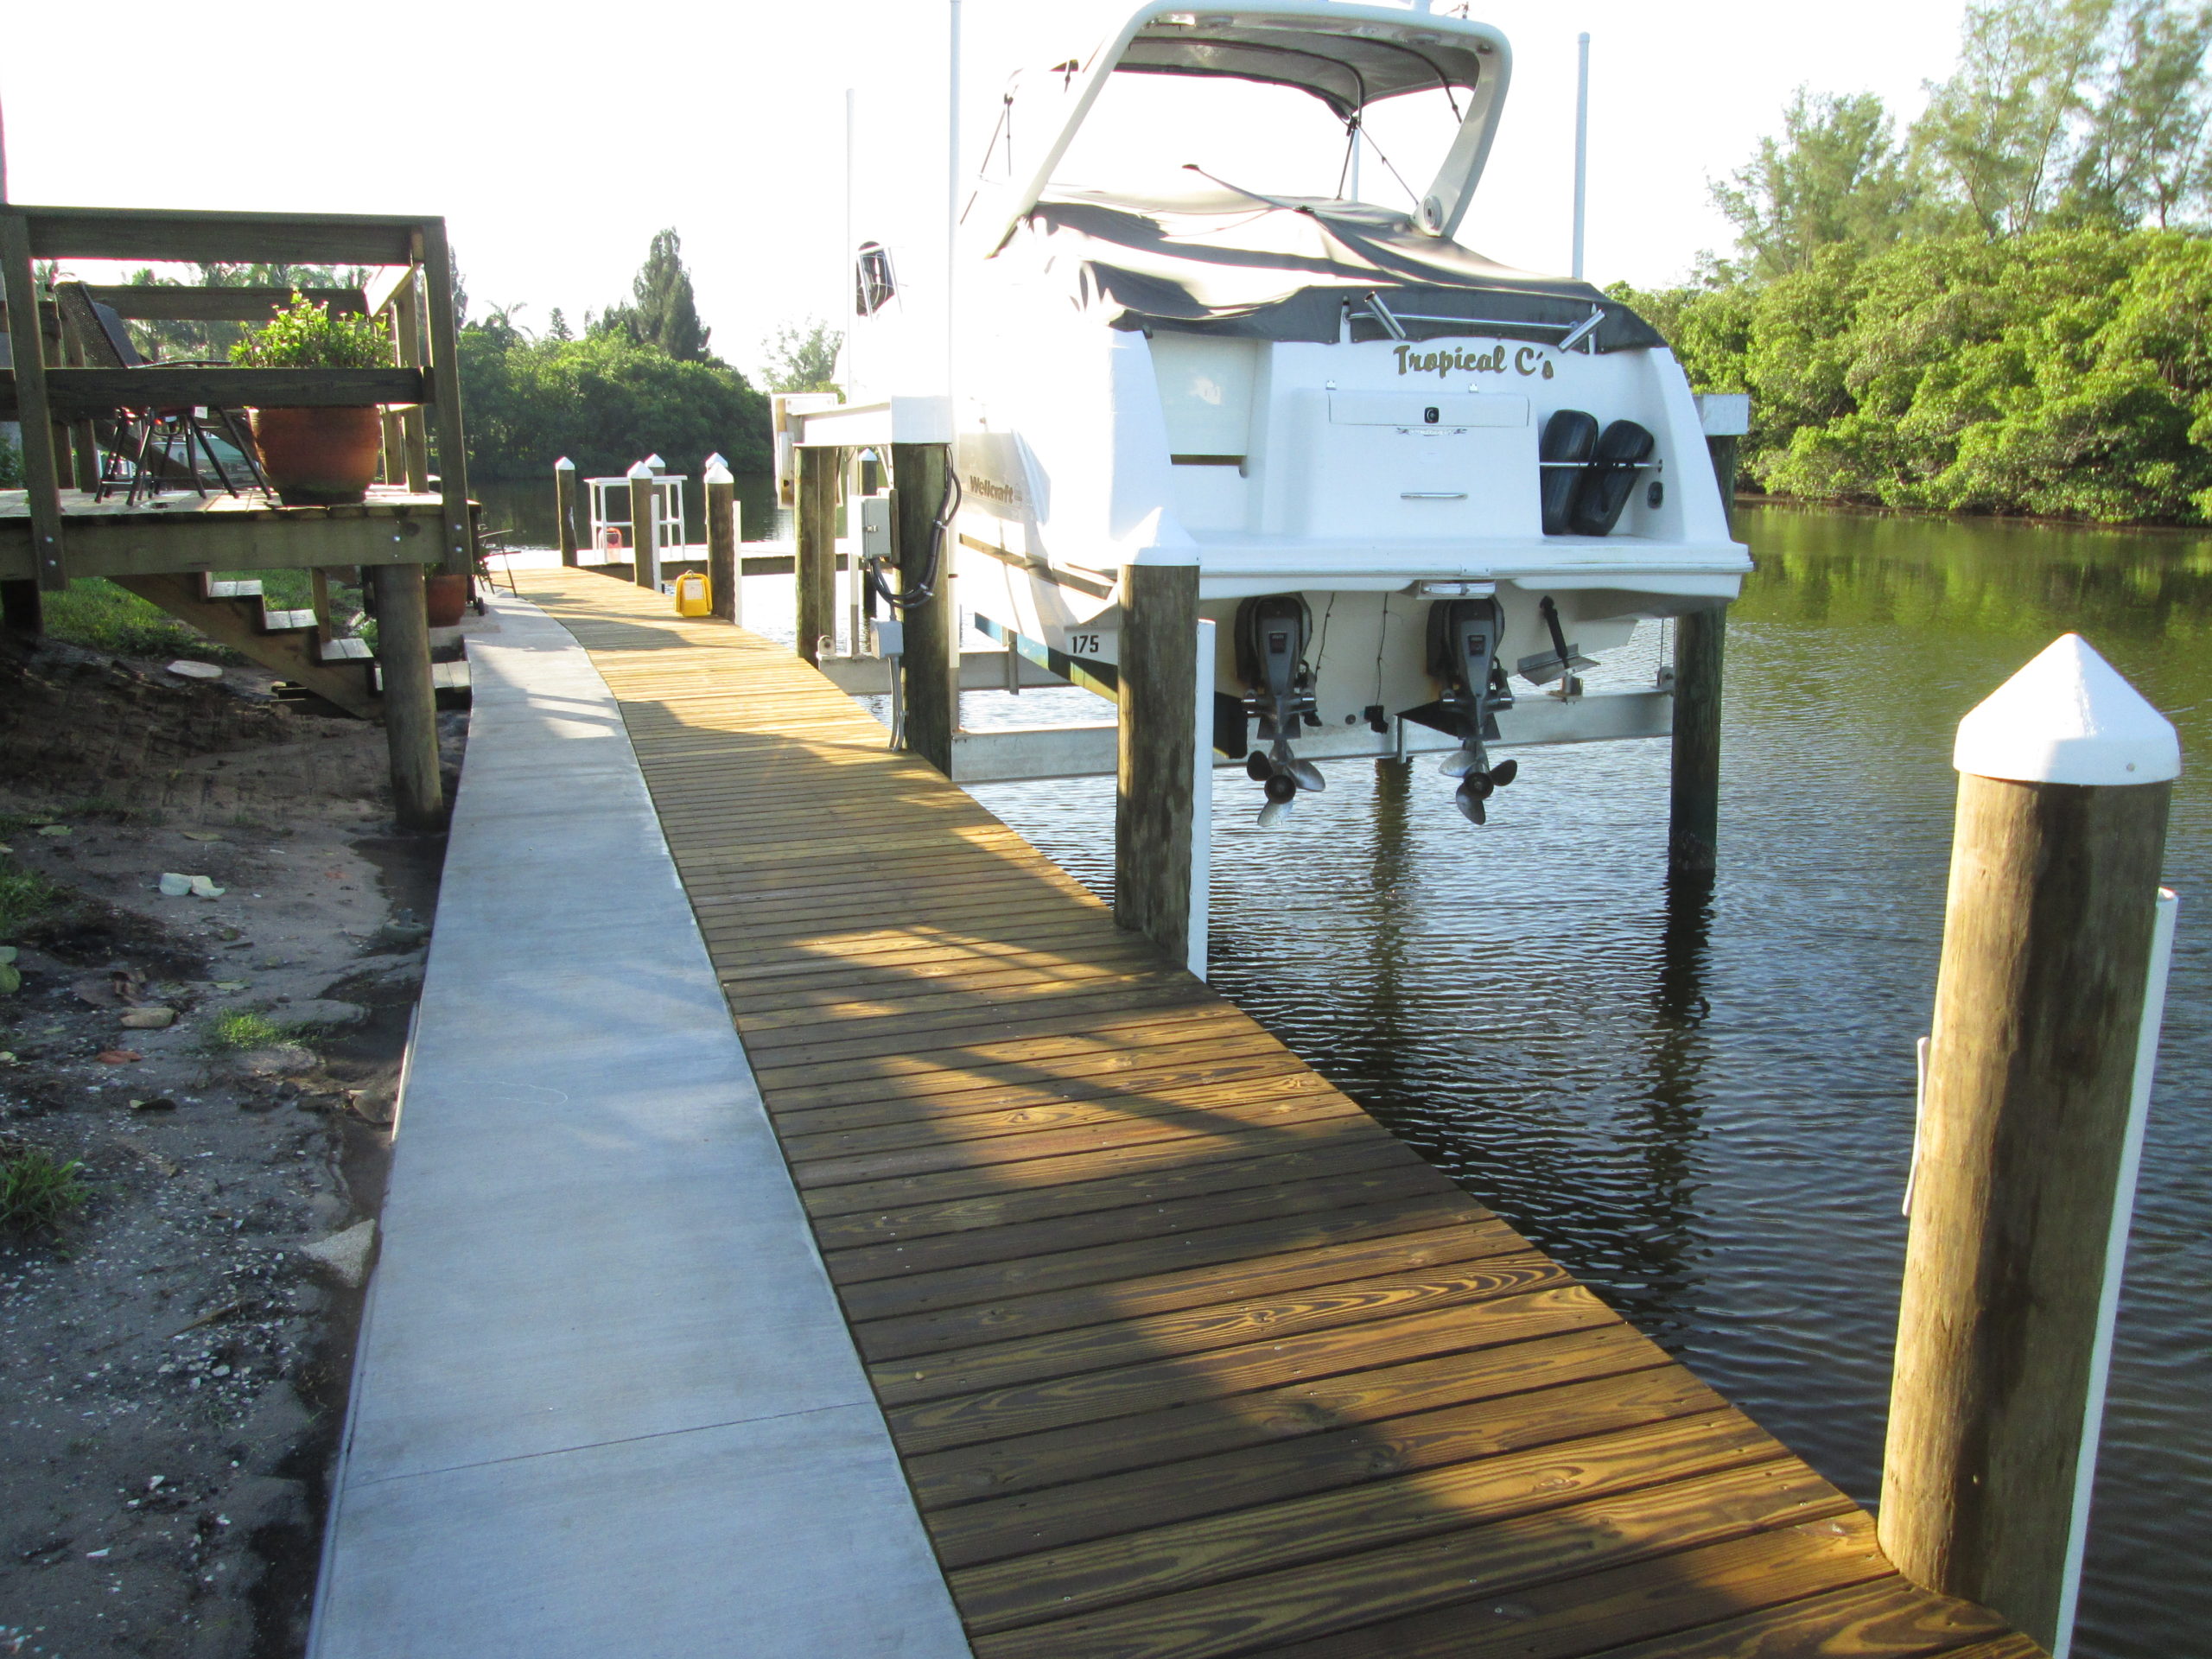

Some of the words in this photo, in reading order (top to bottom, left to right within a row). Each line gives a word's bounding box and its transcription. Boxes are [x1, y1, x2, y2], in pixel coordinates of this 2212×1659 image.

[1393, 345, 1507, 379] Tropical
[1515, 346, 1554, 380] C's
[969, 475, 1014, 505] Wellcraft
[1071, 634, 1099, 655] 175
